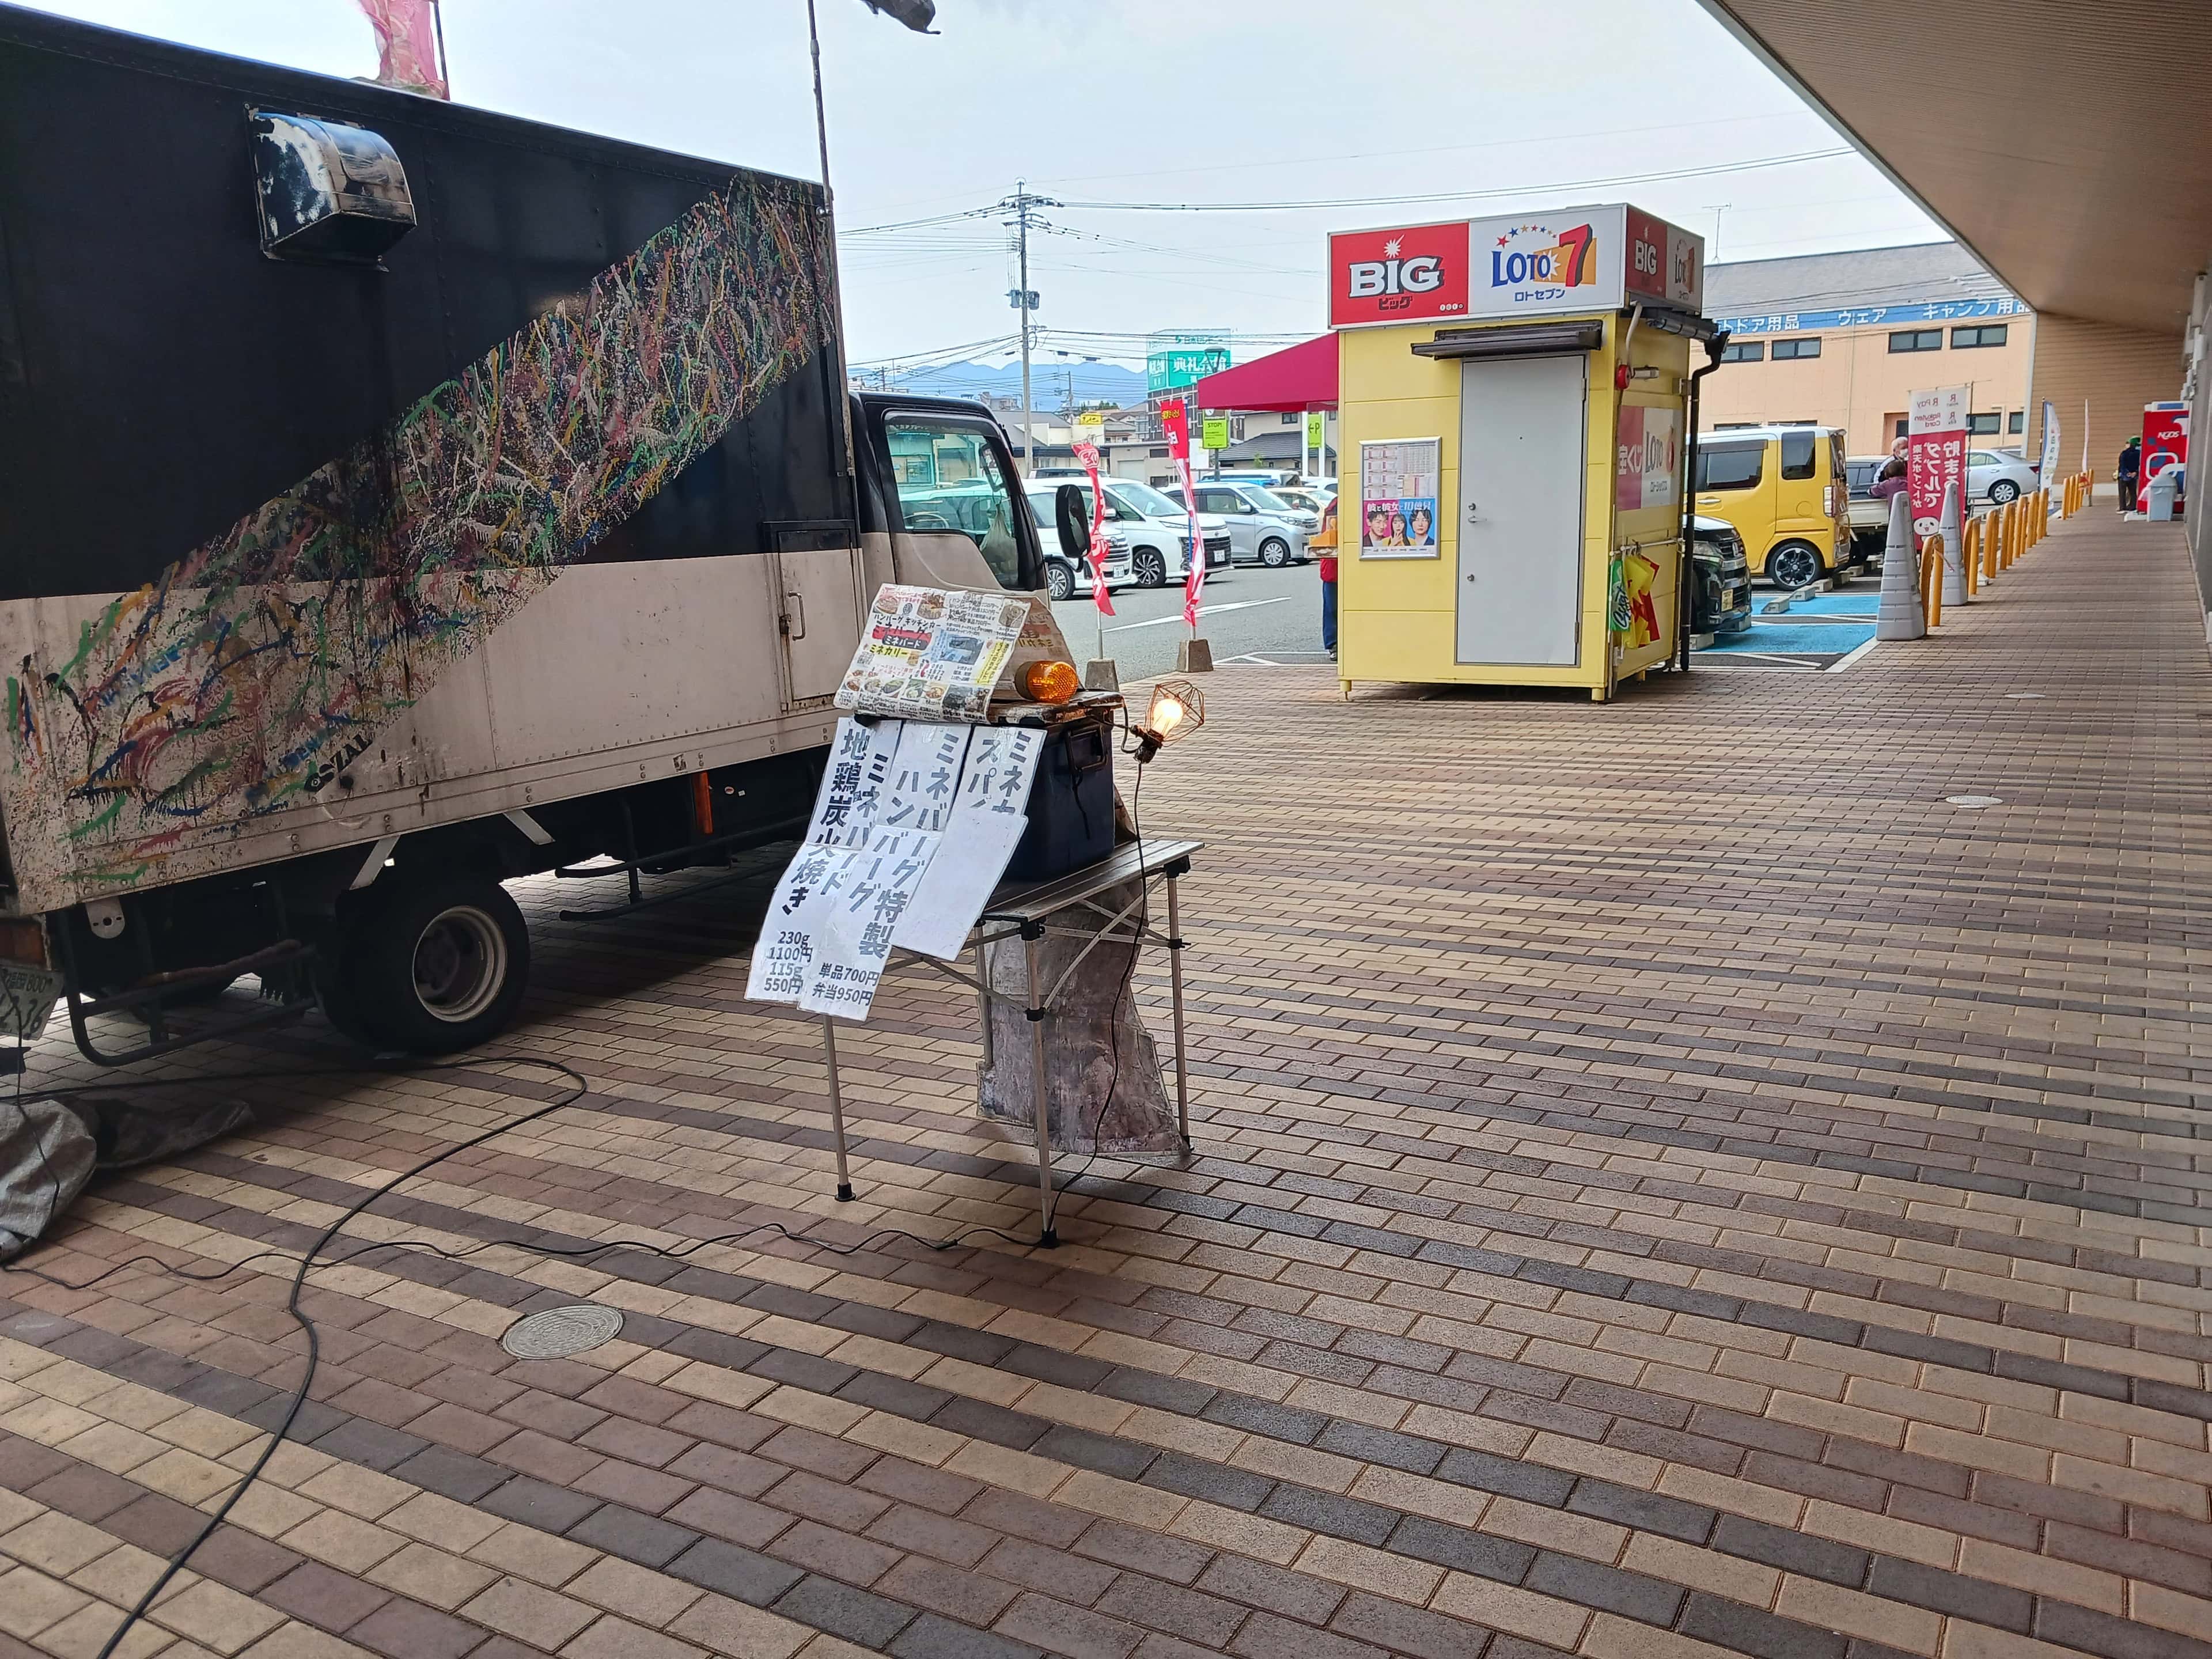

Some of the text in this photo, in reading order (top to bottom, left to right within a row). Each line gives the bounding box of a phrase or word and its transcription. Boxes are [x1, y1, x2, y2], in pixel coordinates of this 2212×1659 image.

[1491, 224, 1593, 287] LOTO 7
[1634, 239, 1657, 275] BIG
[1349, 255, 1444, 298] BIG
[1378, 296, 1413, 310] ビッグ
[1514, 288, 1566, 302] ロトセブン
[1838, 308, 1887, 326] ウェア
[1315, 422, 1320, 434] P
[869, 644, 908, 657] ミネカリー
[885, 635, 922, 649] ミネバード
[968, 739, 1001, 808] スパ
[782, 728, 870, 916] 地鶏炭火焼き
[820, 753, 889, 896] ミネバード
[849, 770, 920, 913] ハンバーグ
[778, 931, 810, 949] 230g
[767, 945, 813, 963] 1100円
[769, 961, 804, 979] 115g
[818, 963, 880, 987] 単品700円
[764, 978, 804, 995] 550円
[812, 983, 874, 1006] 弁当950円
